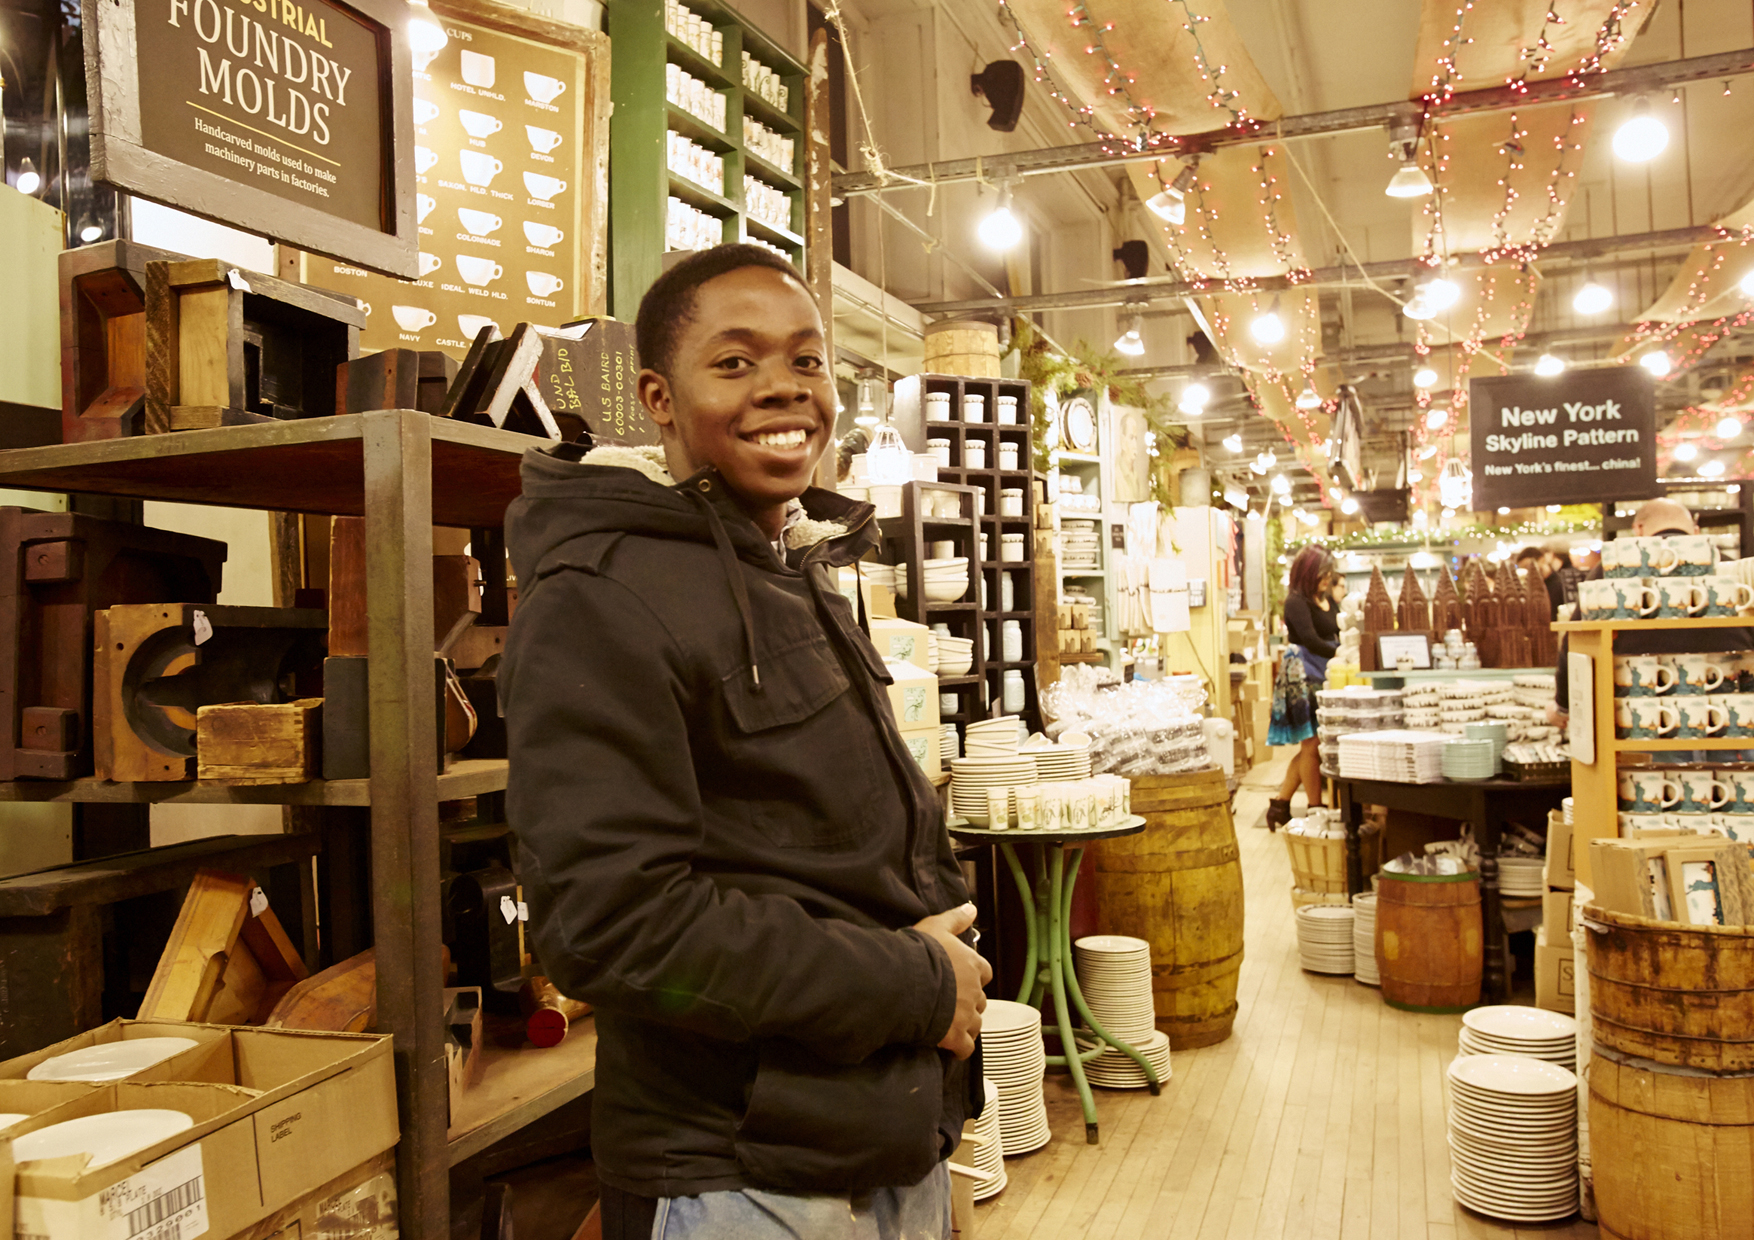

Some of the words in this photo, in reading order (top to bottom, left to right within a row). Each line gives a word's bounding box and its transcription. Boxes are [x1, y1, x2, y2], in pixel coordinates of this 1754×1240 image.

[446, 28, 473, 42] CUPS
[168, 0, 352, 106] FOUNDRY
[197, 46, 330, 145] MOLDS
[450, 82, 476, 94] HOTEL
[525, 98, 560, 113] MARSTON
[195, 117, 253, 151] Handcarved
[254, 143, 281, 162] molds
[282, 155, 303, 172] used
[303, 163, 313, 175] to
[315, 168, 337, 184] make
[469, 138, 486, 147] HUB
[530, 152, 554, 163] DEVON
[205, 142, 256, 172] machinery
[257, 162, 280, 180] parts
[281, 170, 290, 183] in
[291, 174, 330, 198] factories.
[438, 179, 467, 191] SAXON.
[470, 186, 488, 195] HLD.
[527, 197, 555, 209] LORBER
[456, 233, 502, 247] COLONNADE
[525, 246, 555, 257] SHARON
[333, 266, 368, 278] BOSTON
[441, 283, 466, 293] IDEAL.
[468, 287, 490, 297] WELD
[491, 291, 508, 300] HLD.
[399, 333, 421, 342] NAVY
[436, 338, 466, 348] CASTLE.
[601, 352, 611, 392] BAIRD
[615, 351, 625, 435] 60003-00301
[1501, 406, 1558, 427] New
[1562, 399, 1622, 422] York
[1485, 432, 1558, 454] Skyline
[1563, 428, 1639, 447] Pattern
[1484, 463, 1513, 476] New
[1515, 462, 1552, 474] York's
[1554, 460, 1600, 472] finest...
[1601, 457, 1641, 470] china!
[270, 1112, 302, 1134] SHIPPING
[271, 1127, 292, 1143] LABEL
